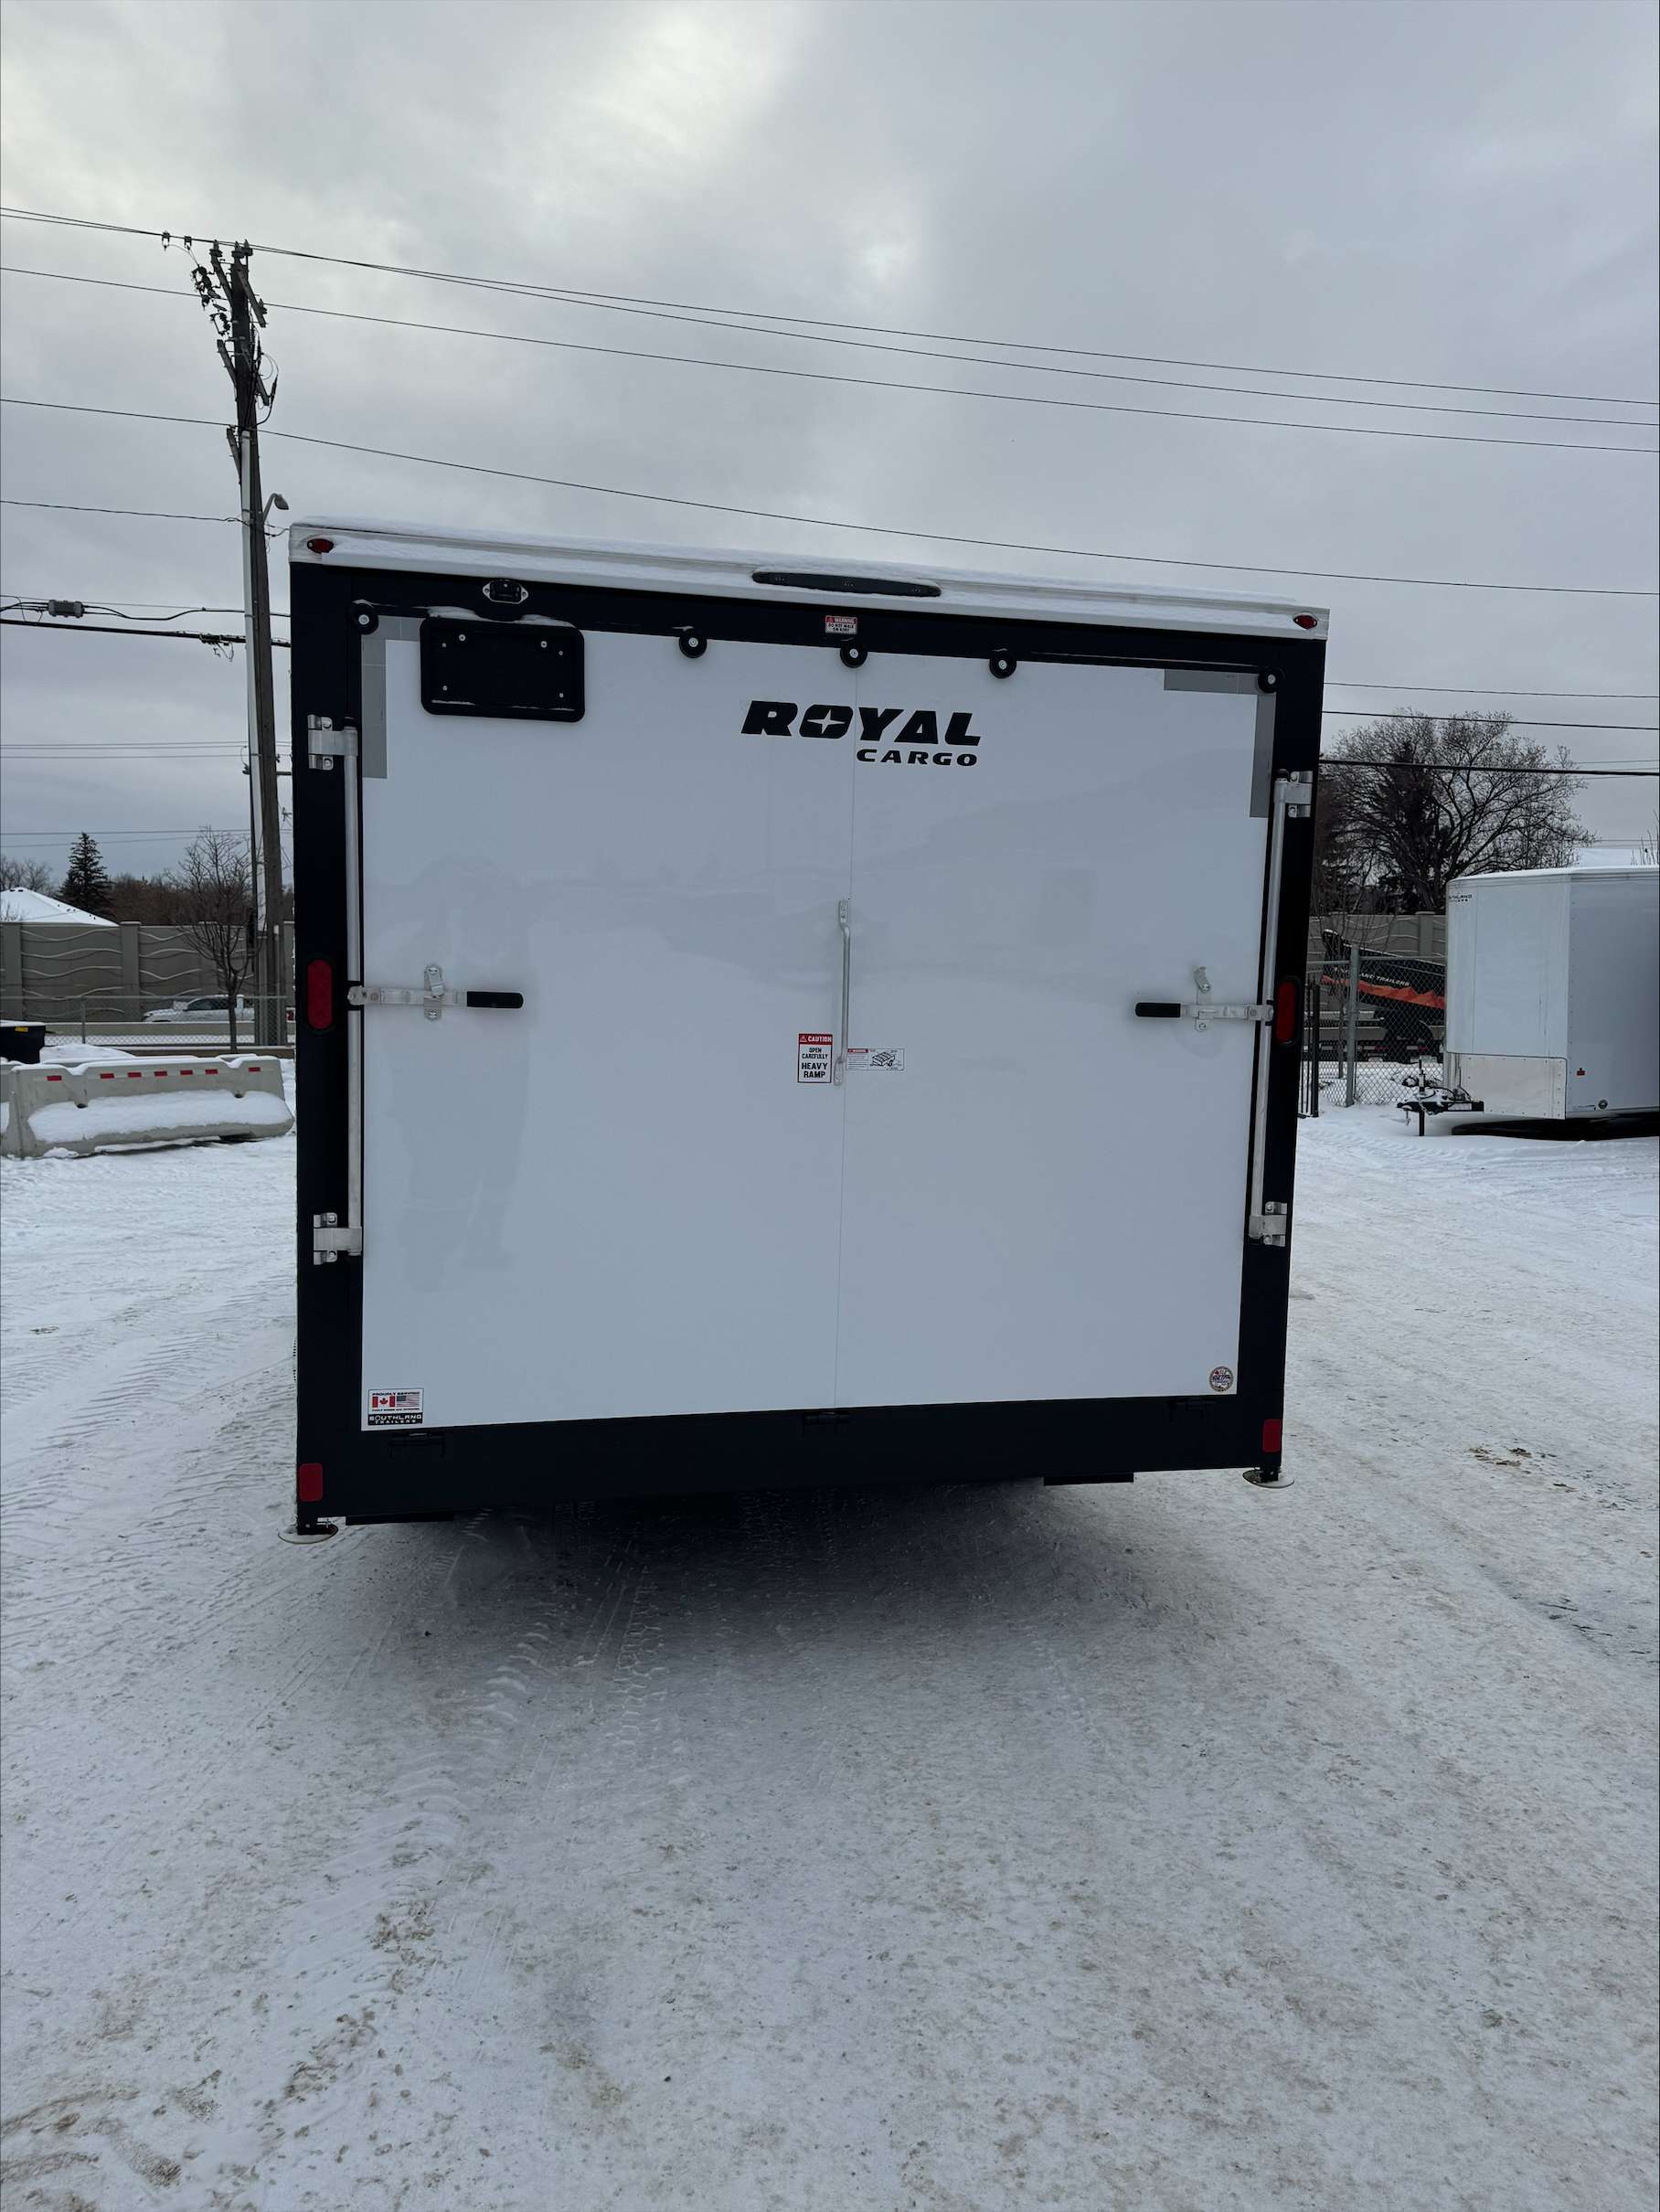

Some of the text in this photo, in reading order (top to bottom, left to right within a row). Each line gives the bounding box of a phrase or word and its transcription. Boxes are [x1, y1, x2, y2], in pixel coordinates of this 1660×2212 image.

[740, 700, 982, 746] ROYAL
[857, 749, 978, 767] CARGO
[803, 1070, 826, 1079] RAMP
